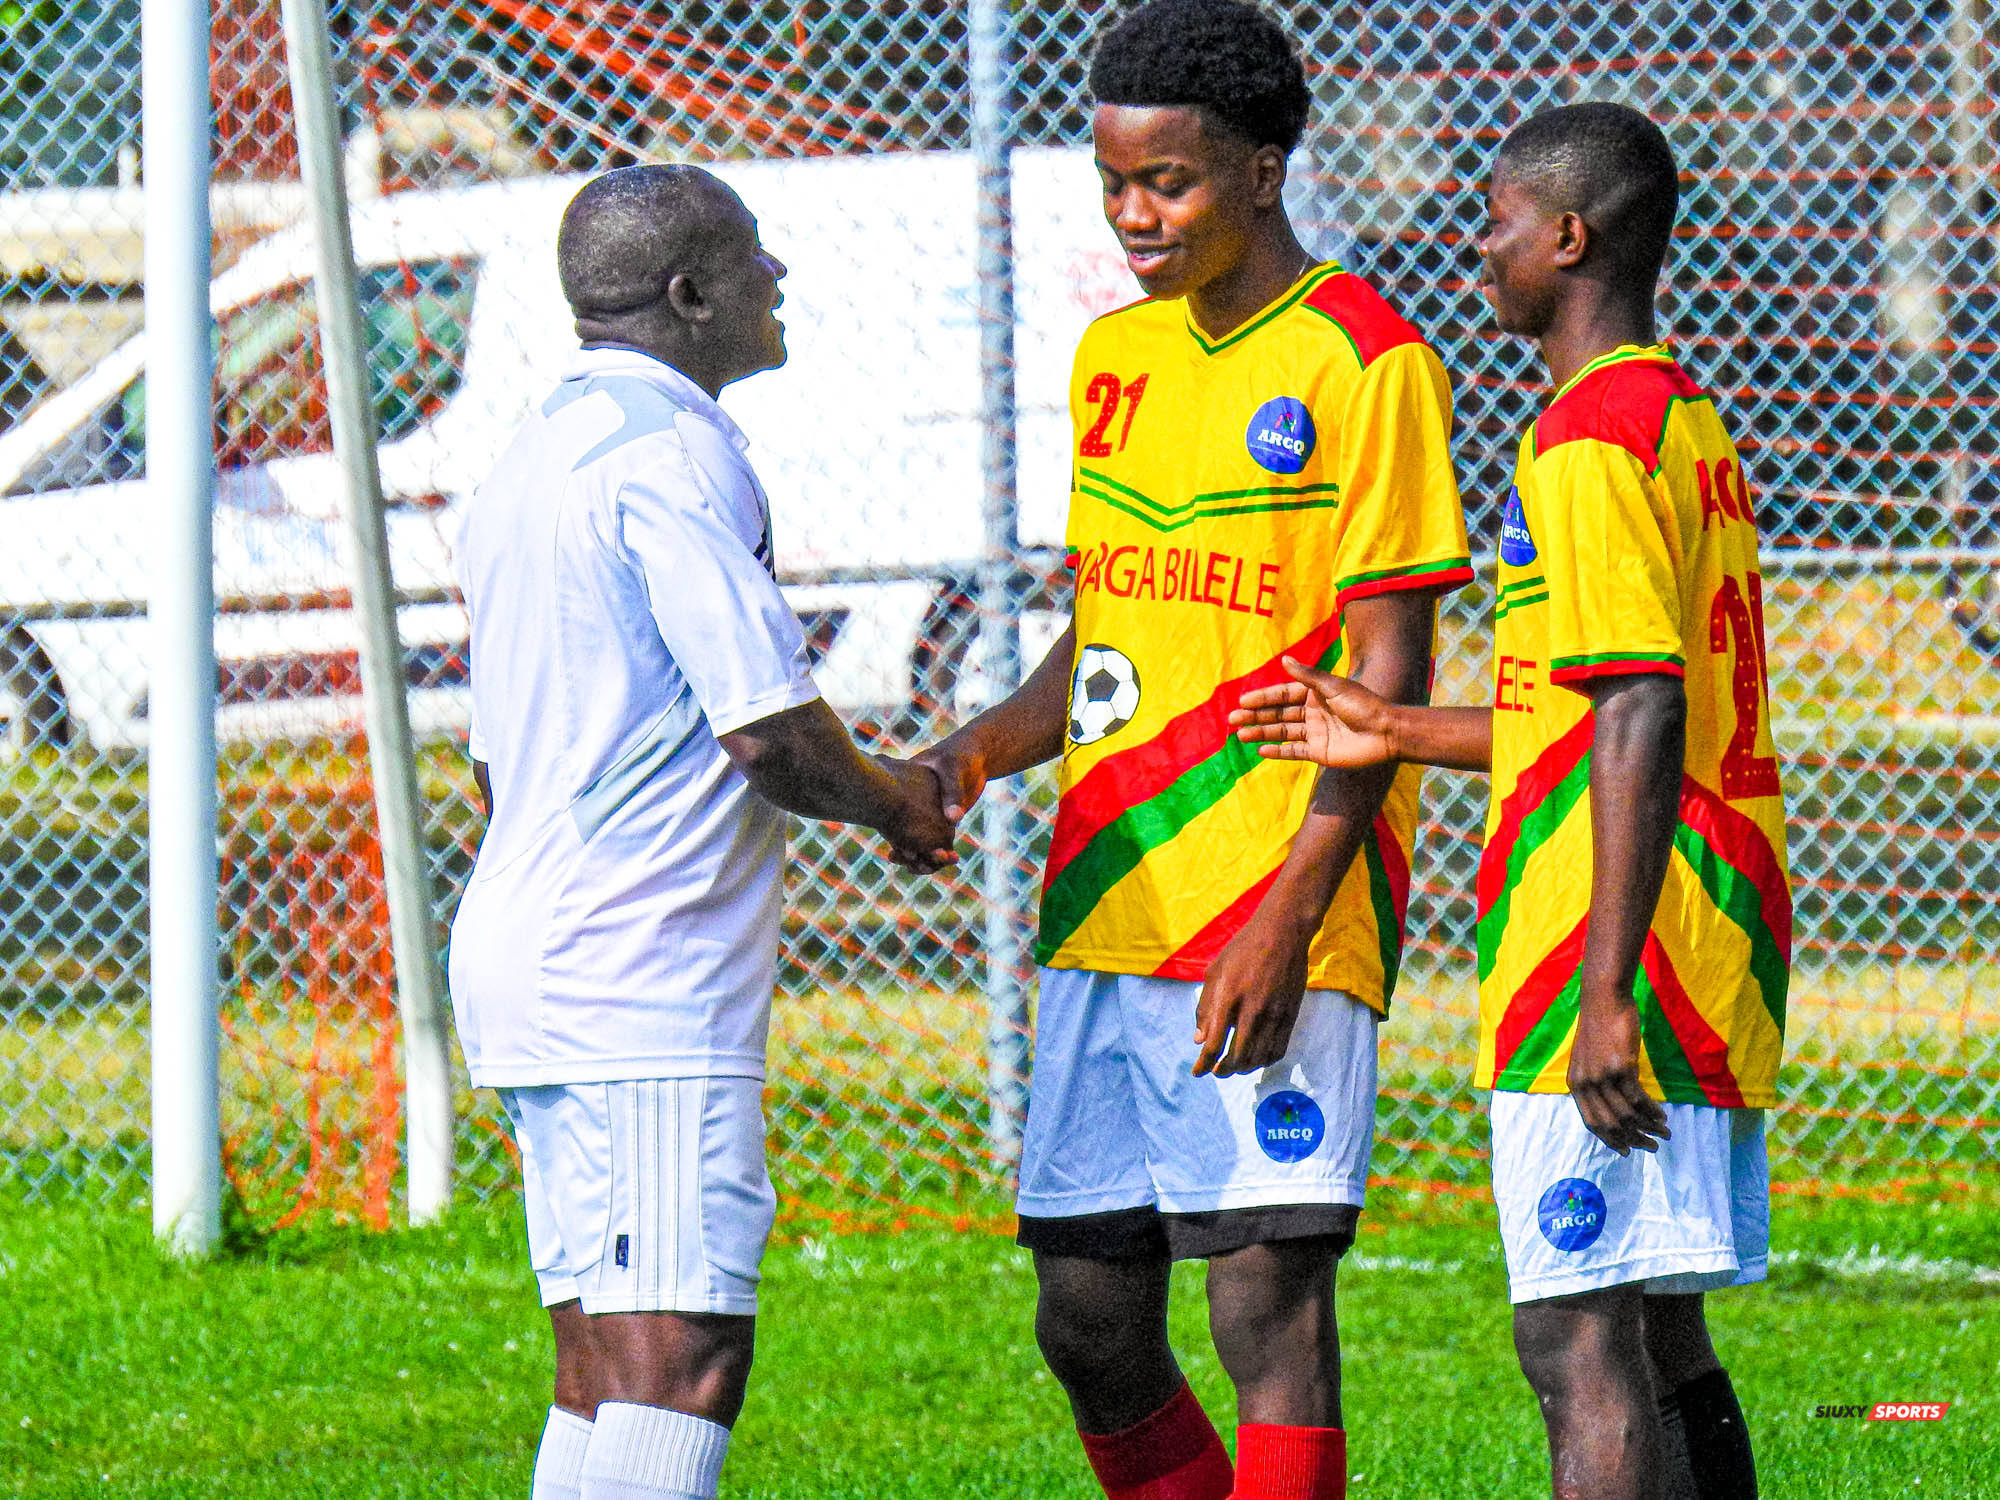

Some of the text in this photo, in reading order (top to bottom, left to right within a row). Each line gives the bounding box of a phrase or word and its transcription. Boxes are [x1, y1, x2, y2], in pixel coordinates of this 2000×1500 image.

[1080, 372, 1150, 458] 21
[1257, 429, 1305, 457] ARCQ
[1267, 1127, 1313, 1142] ARCQ
[1551, 1212, 1597, 1230] ARCQ
